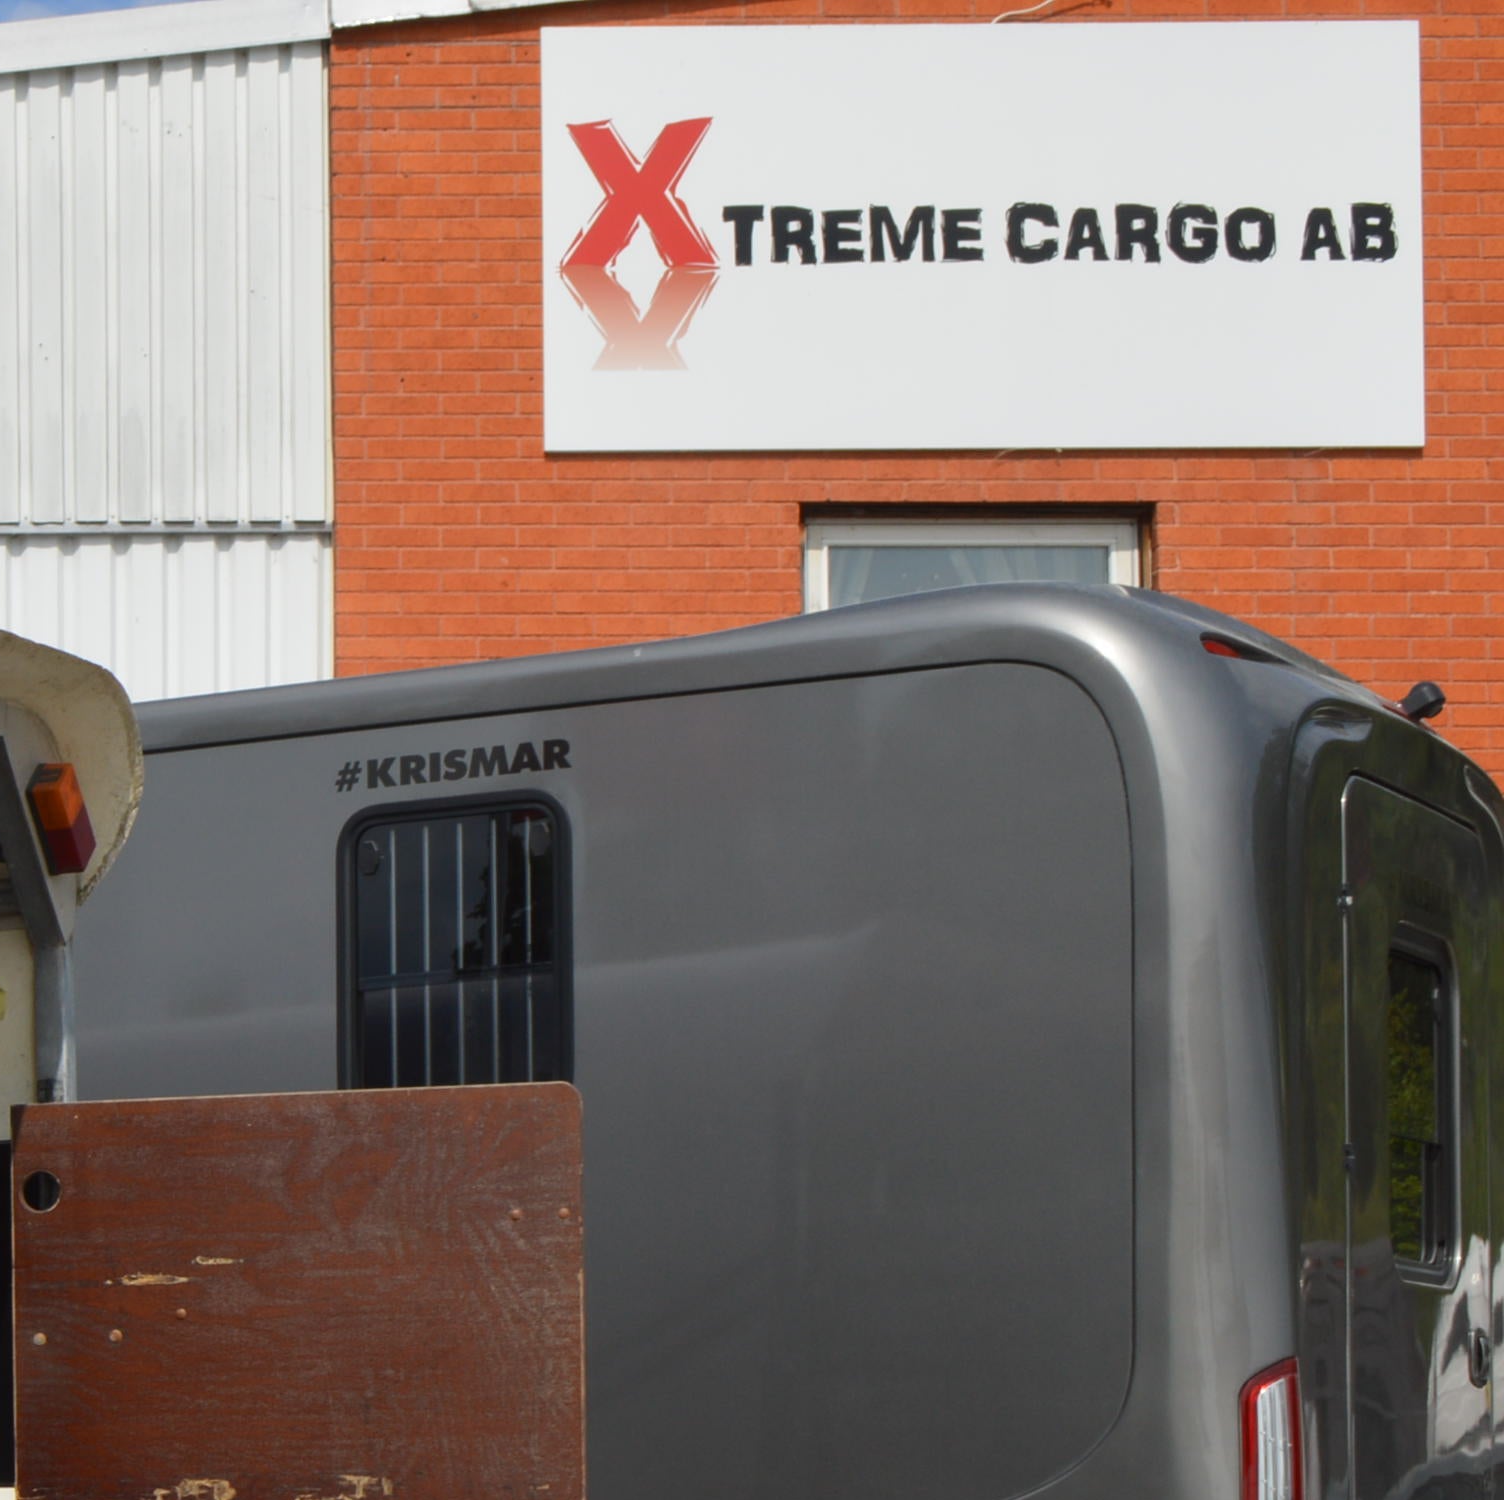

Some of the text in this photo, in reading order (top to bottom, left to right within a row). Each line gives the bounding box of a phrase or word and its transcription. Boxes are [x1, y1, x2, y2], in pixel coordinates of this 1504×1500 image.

[1005, 200, 1278, 267] CARGO
[1301, 201, 1401, 265] AB
[335, 738, 573, 793] #KRISMAR
